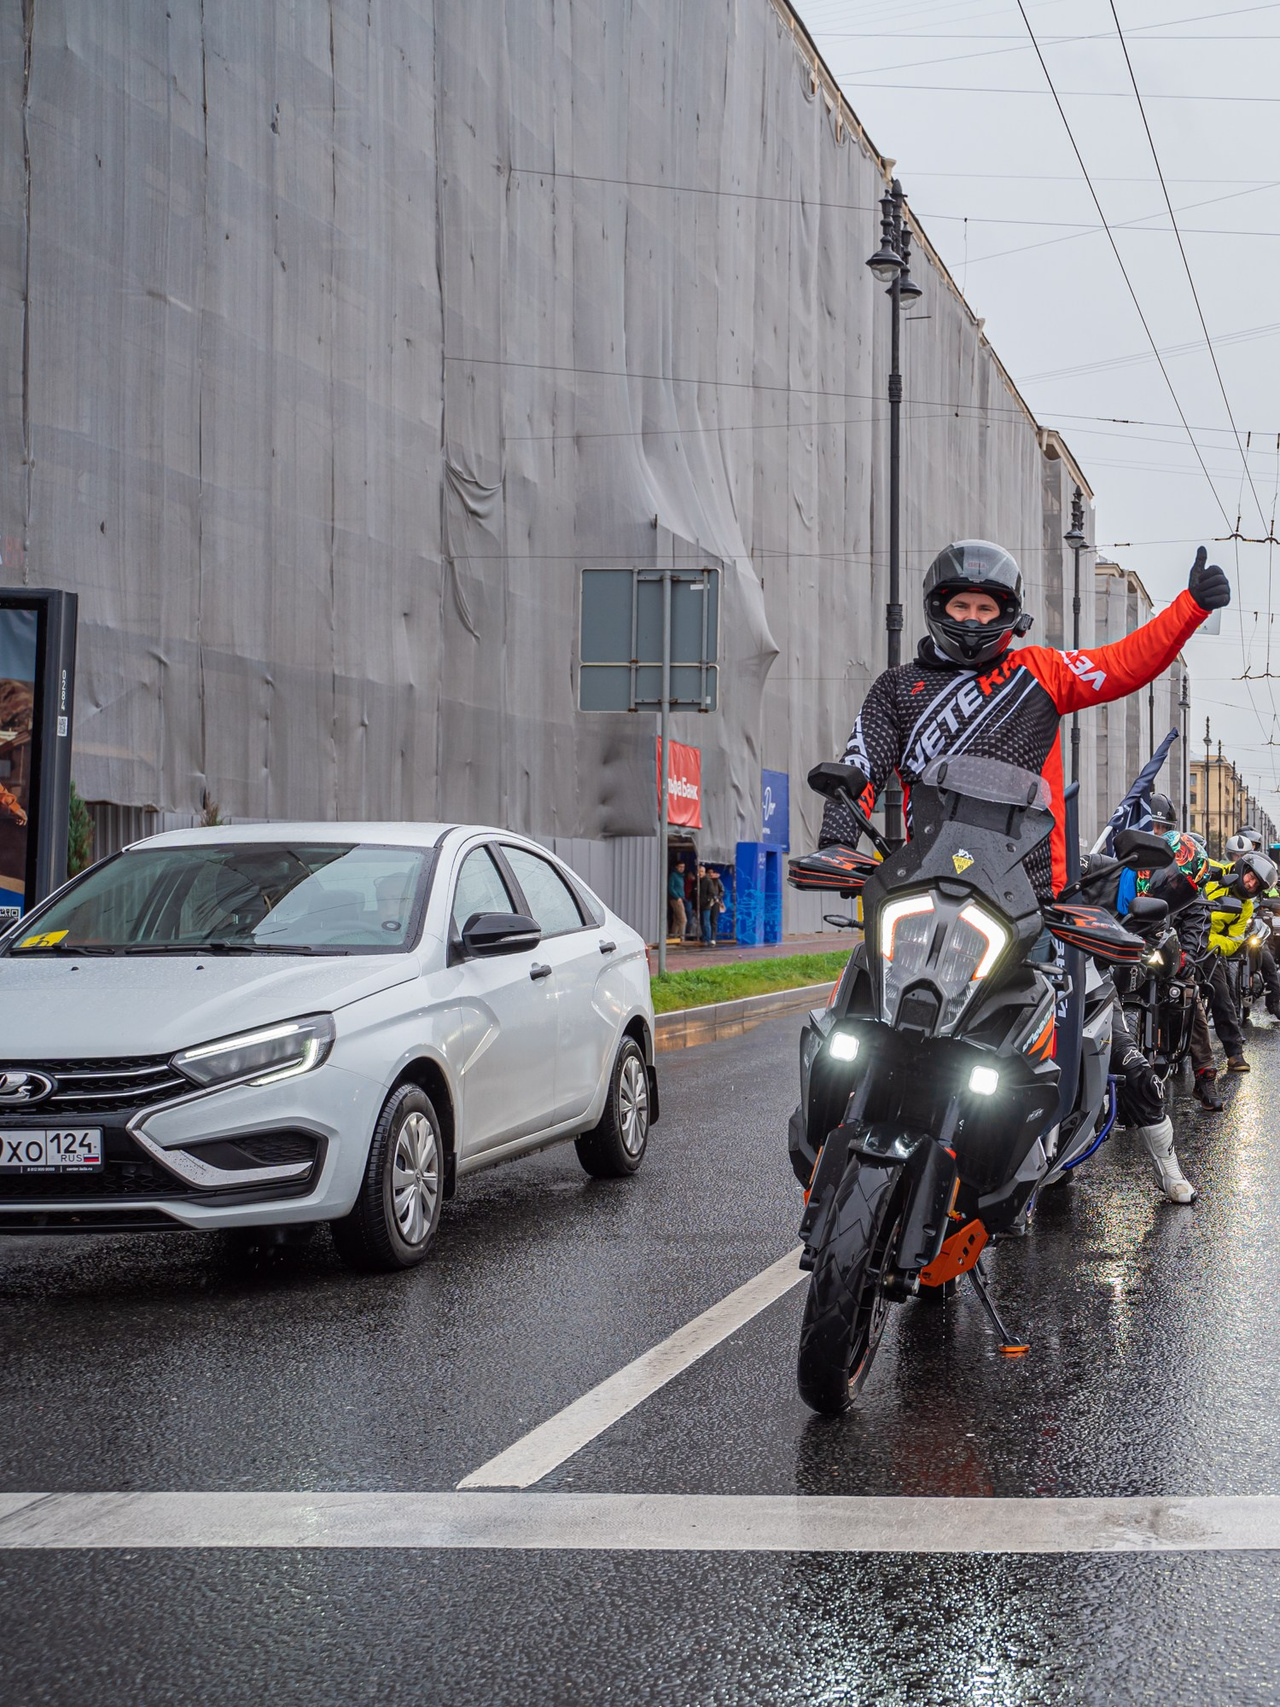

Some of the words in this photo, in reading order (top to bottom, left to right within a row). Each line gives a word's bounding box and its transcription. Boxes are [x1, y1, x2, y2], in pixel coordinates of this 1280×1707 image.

[0, 1136, 43, 1163] XO
[49, 1132, 92, 1154] 124
[60, 1154, 83, 1163] RUS
